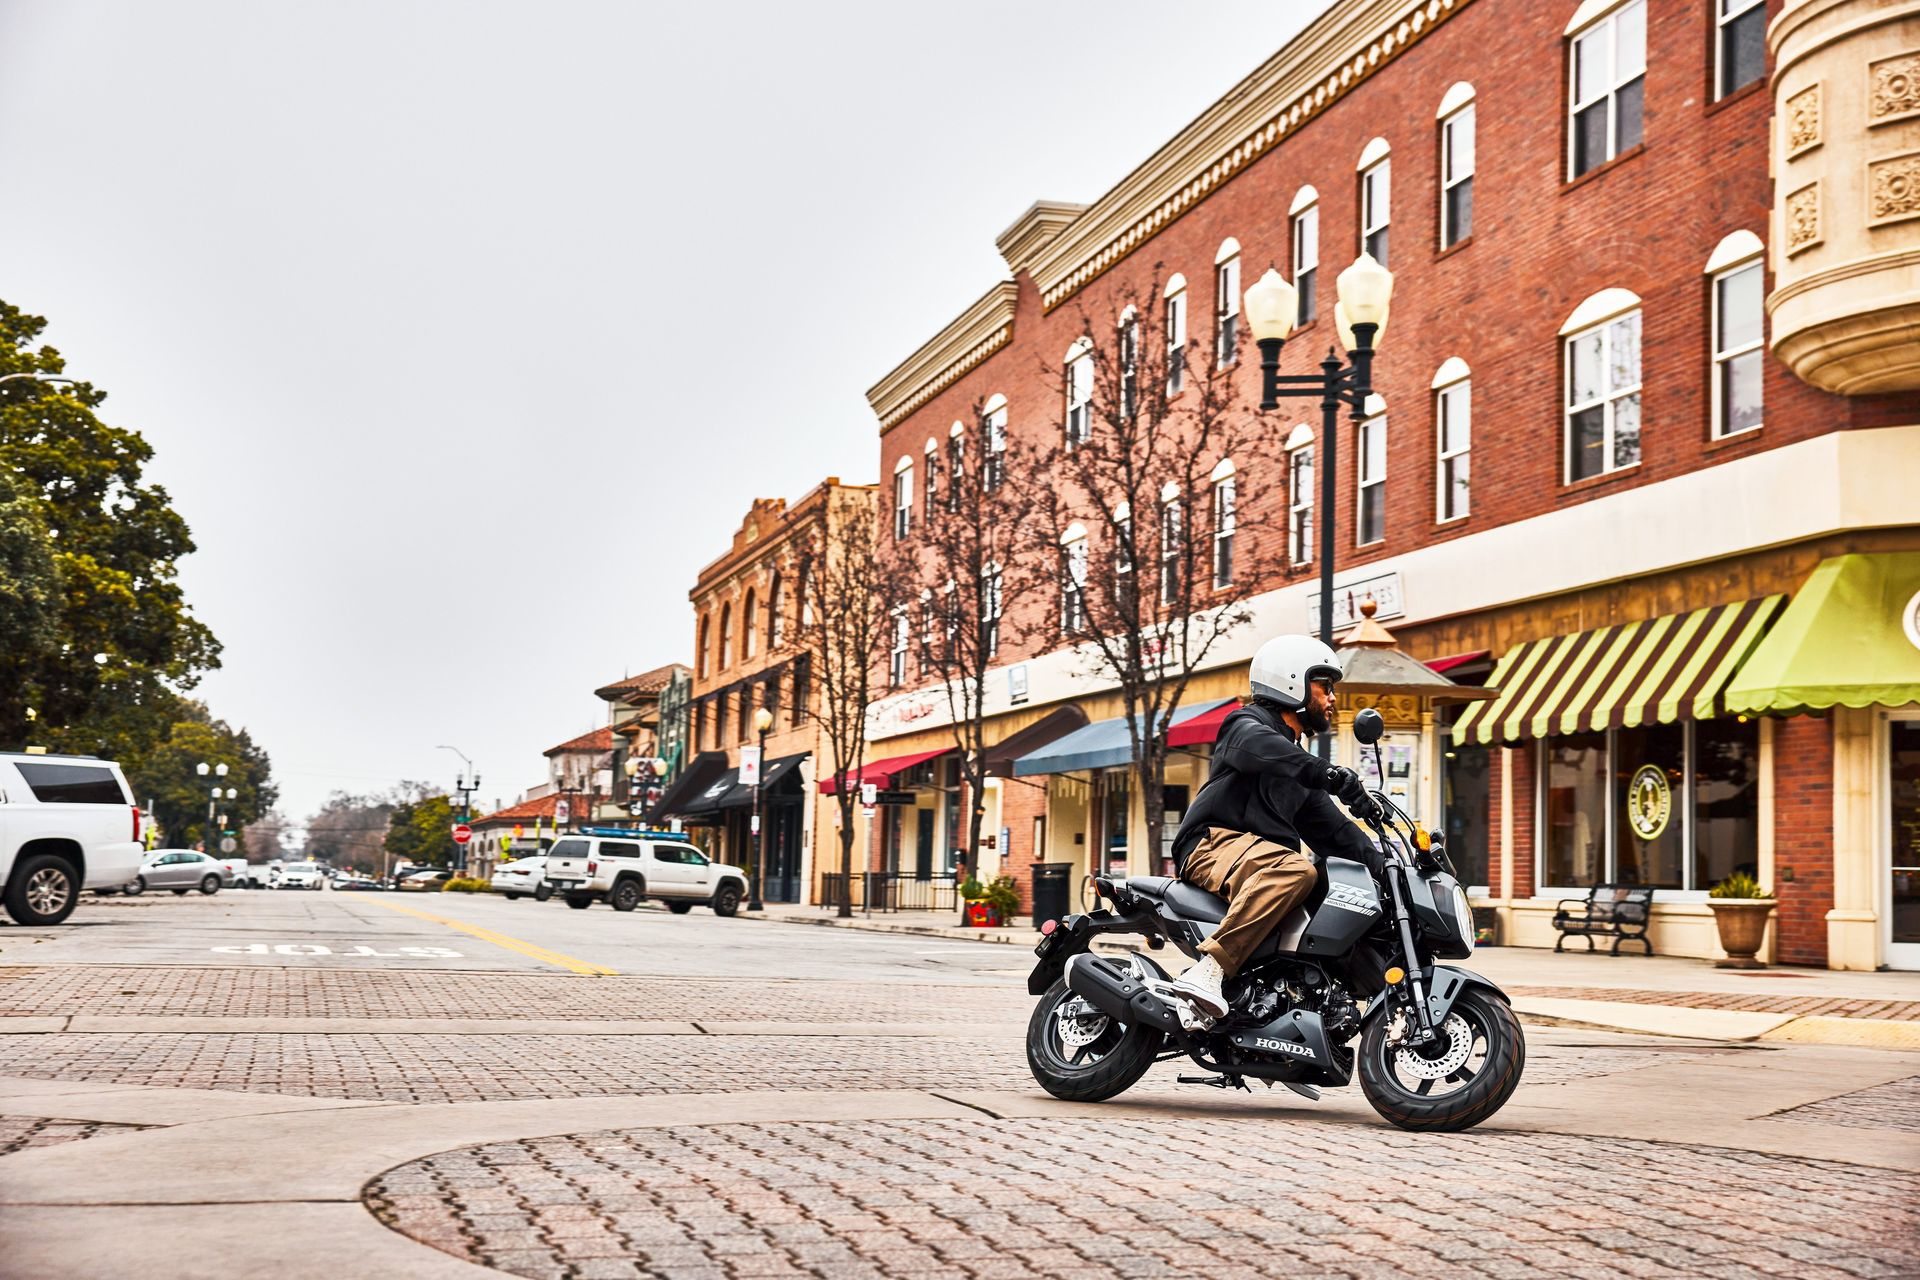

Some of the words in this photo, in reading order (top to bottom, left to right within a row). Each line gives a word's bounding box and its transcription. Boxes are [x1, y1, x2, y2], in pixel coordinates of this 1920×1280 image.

[1326, 899, 1347, 908] HONDA
[210, 943, 465, 958] STOP
[1255, 1037, 1316, 1059] HONDA
